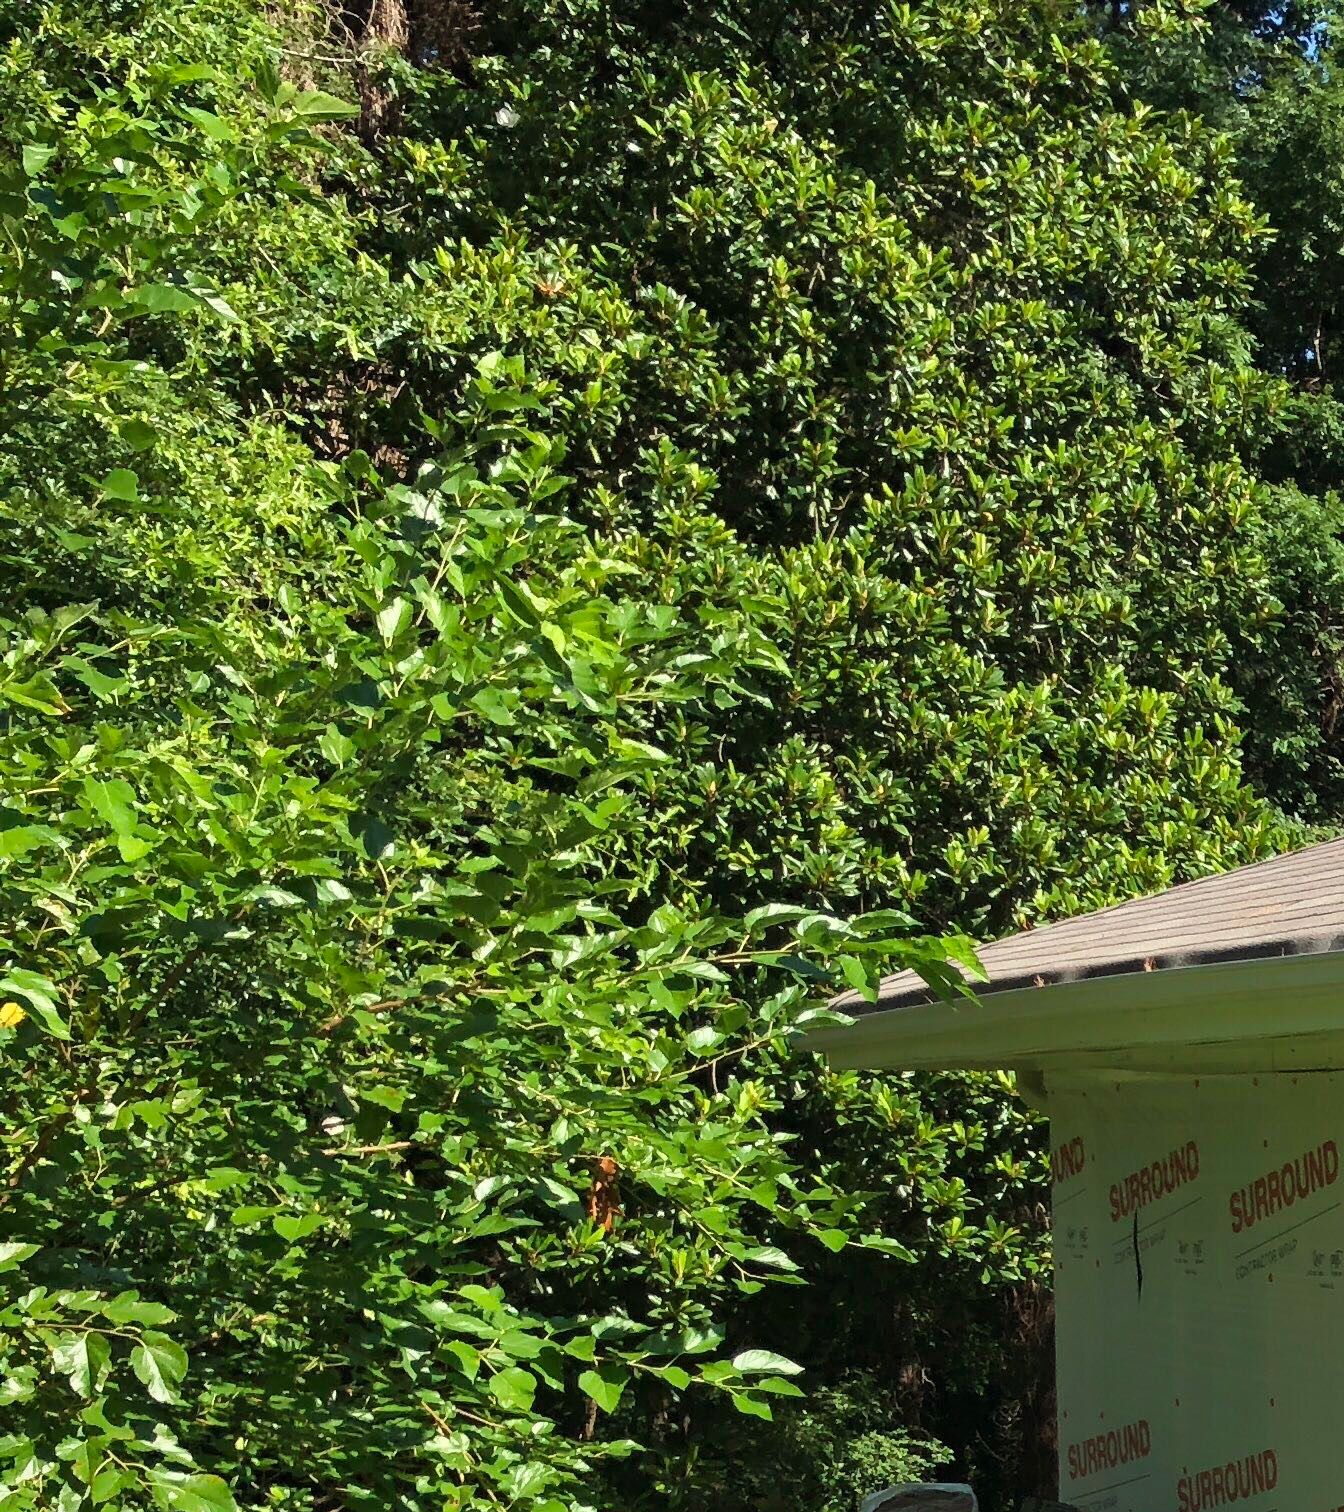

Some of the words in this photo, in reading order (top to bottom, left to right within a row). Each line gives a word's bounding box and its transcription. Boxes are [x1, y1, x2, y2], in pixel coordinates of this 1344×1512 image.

[1109, 1140, 1200, 1223] SURROUND
[1229, 1140, 1340, 1234] SURROUND
[1067, 1419, 1151, 1481] SURROUND
